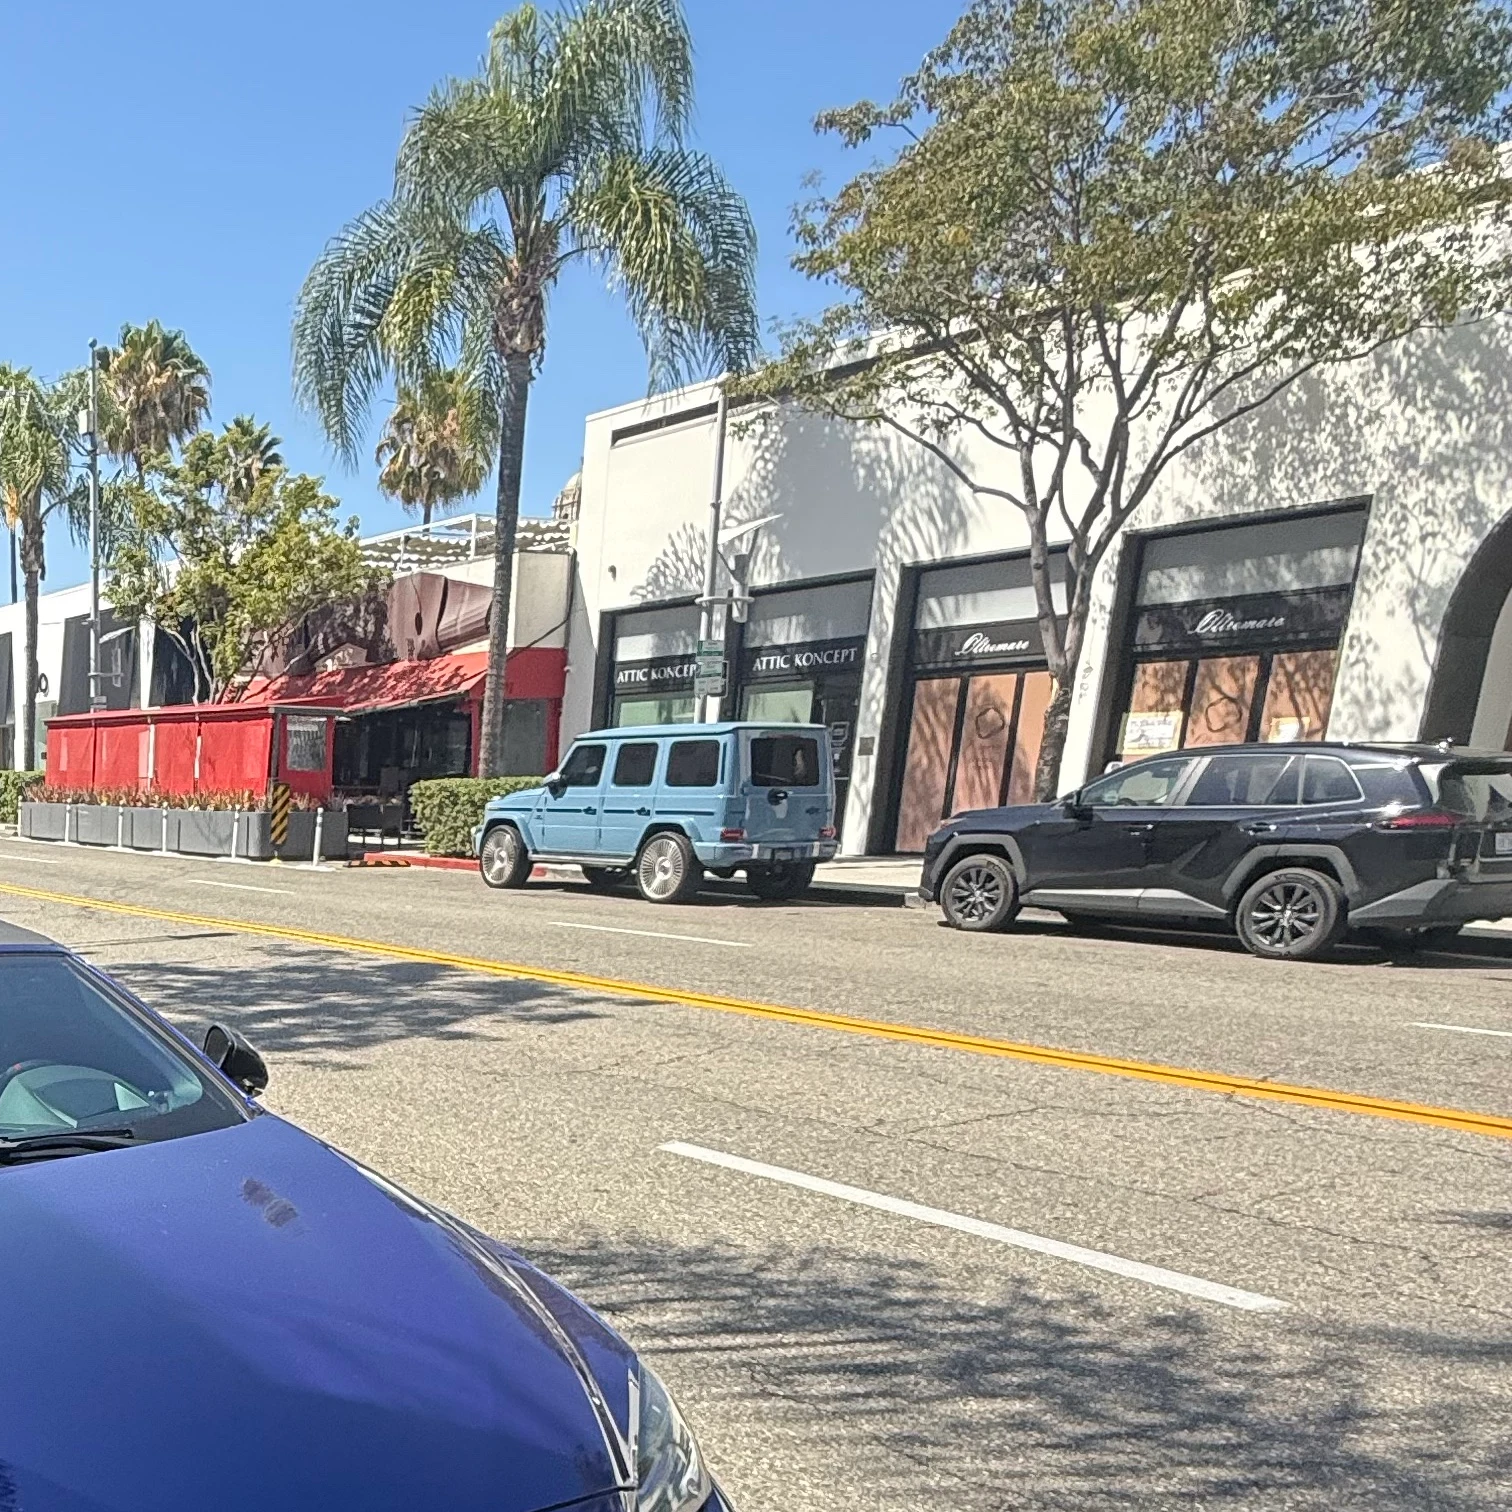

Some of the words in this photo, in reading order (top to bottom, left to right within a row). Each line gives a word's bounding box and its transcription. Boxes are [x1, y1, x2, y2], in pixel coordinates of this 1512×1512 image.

[1186, 608, 1285, 634] Oltremare
[954, 632, 1030, 656] Oltremare
[752, 654, 791, 671] ATTIC
[794, 647, 858, 667] KONCEPT
[616, 668, 648, 684] ATTIC
[650, 663, 697, 680] KONCEP
